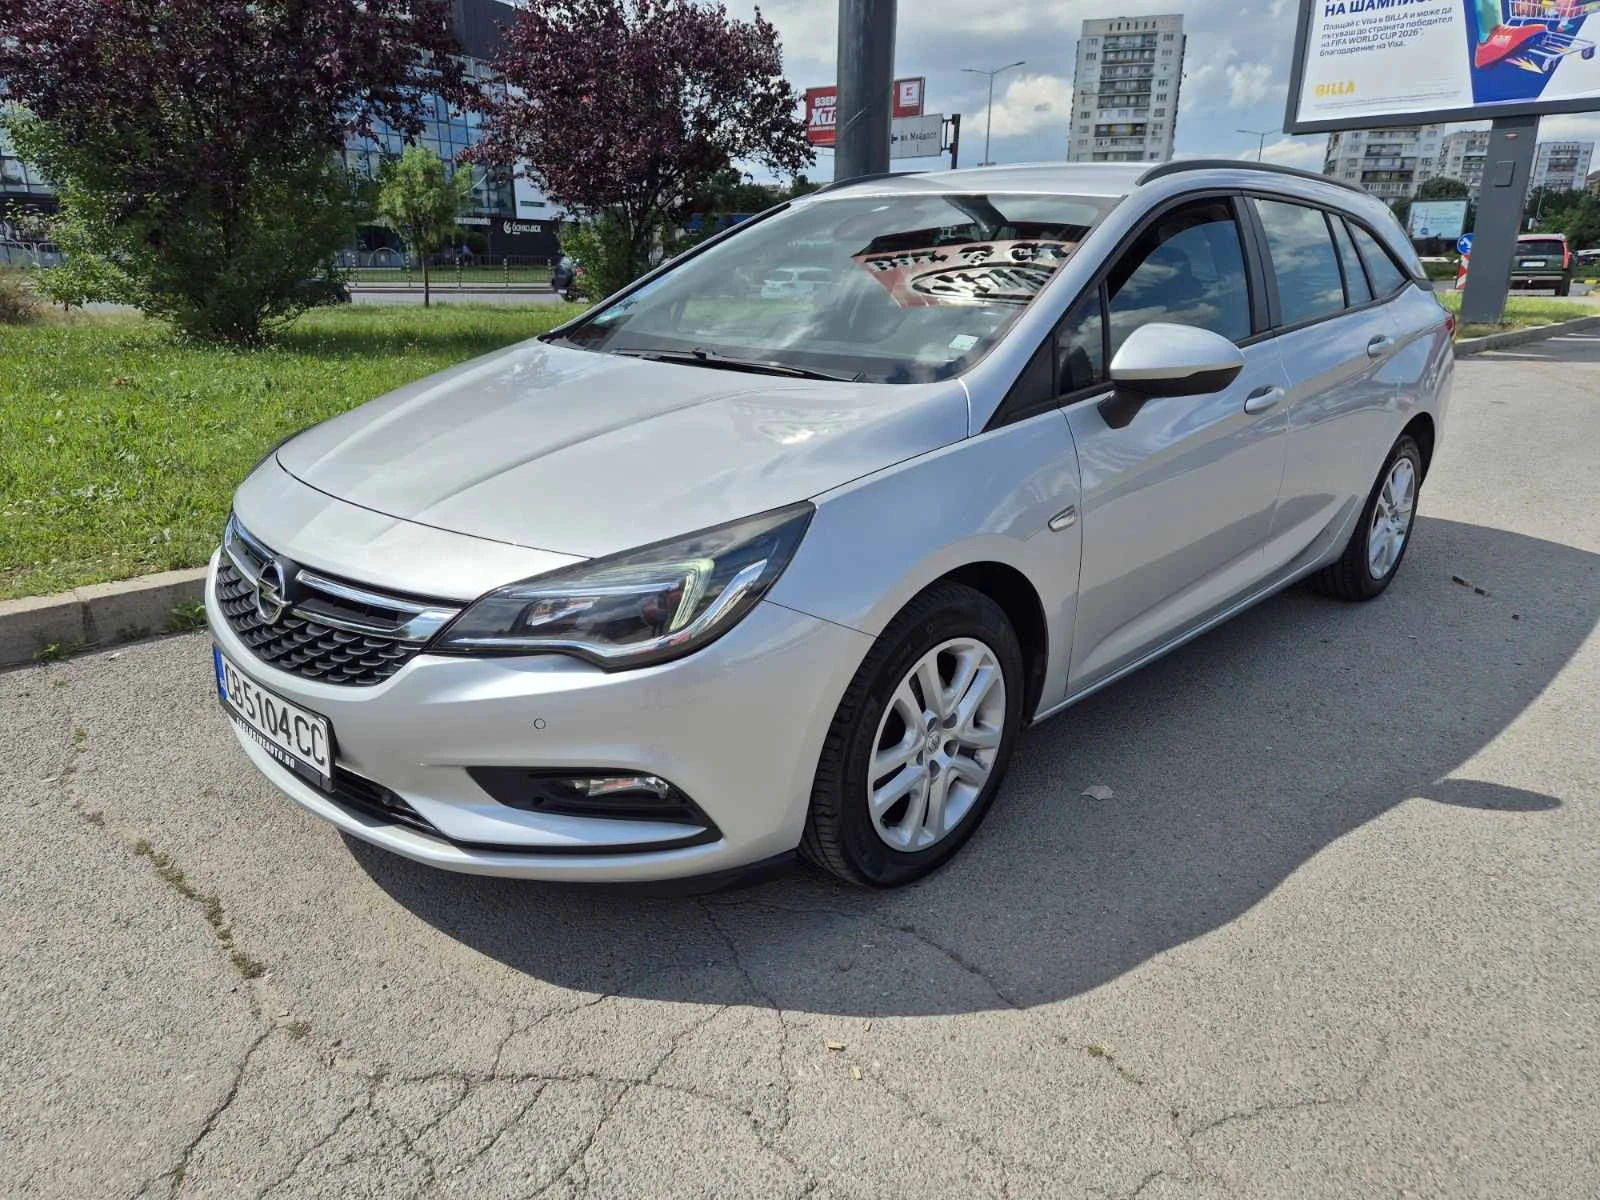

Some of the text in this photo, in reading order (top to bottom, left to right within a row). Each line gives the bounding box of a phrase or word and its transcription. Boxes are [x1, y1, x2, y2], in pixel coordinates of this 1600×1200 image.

[1324, 3, 1346, 17] НА
[1361, 18, 1378, 26] Visa
[1385, 14, 1408, 23] BILLA
[1416, 9, 1440, 17] може
[1368, 22, 1405, 34] страната
[1406, 16, 1453, 29] победител
[1330, 38, 1348, 47] FIFA
[1348, 35, 1379, 45] WORLD
[1380, 32, 1398, 41] CUP
[1315, 80, 1355, 97] BILLA
